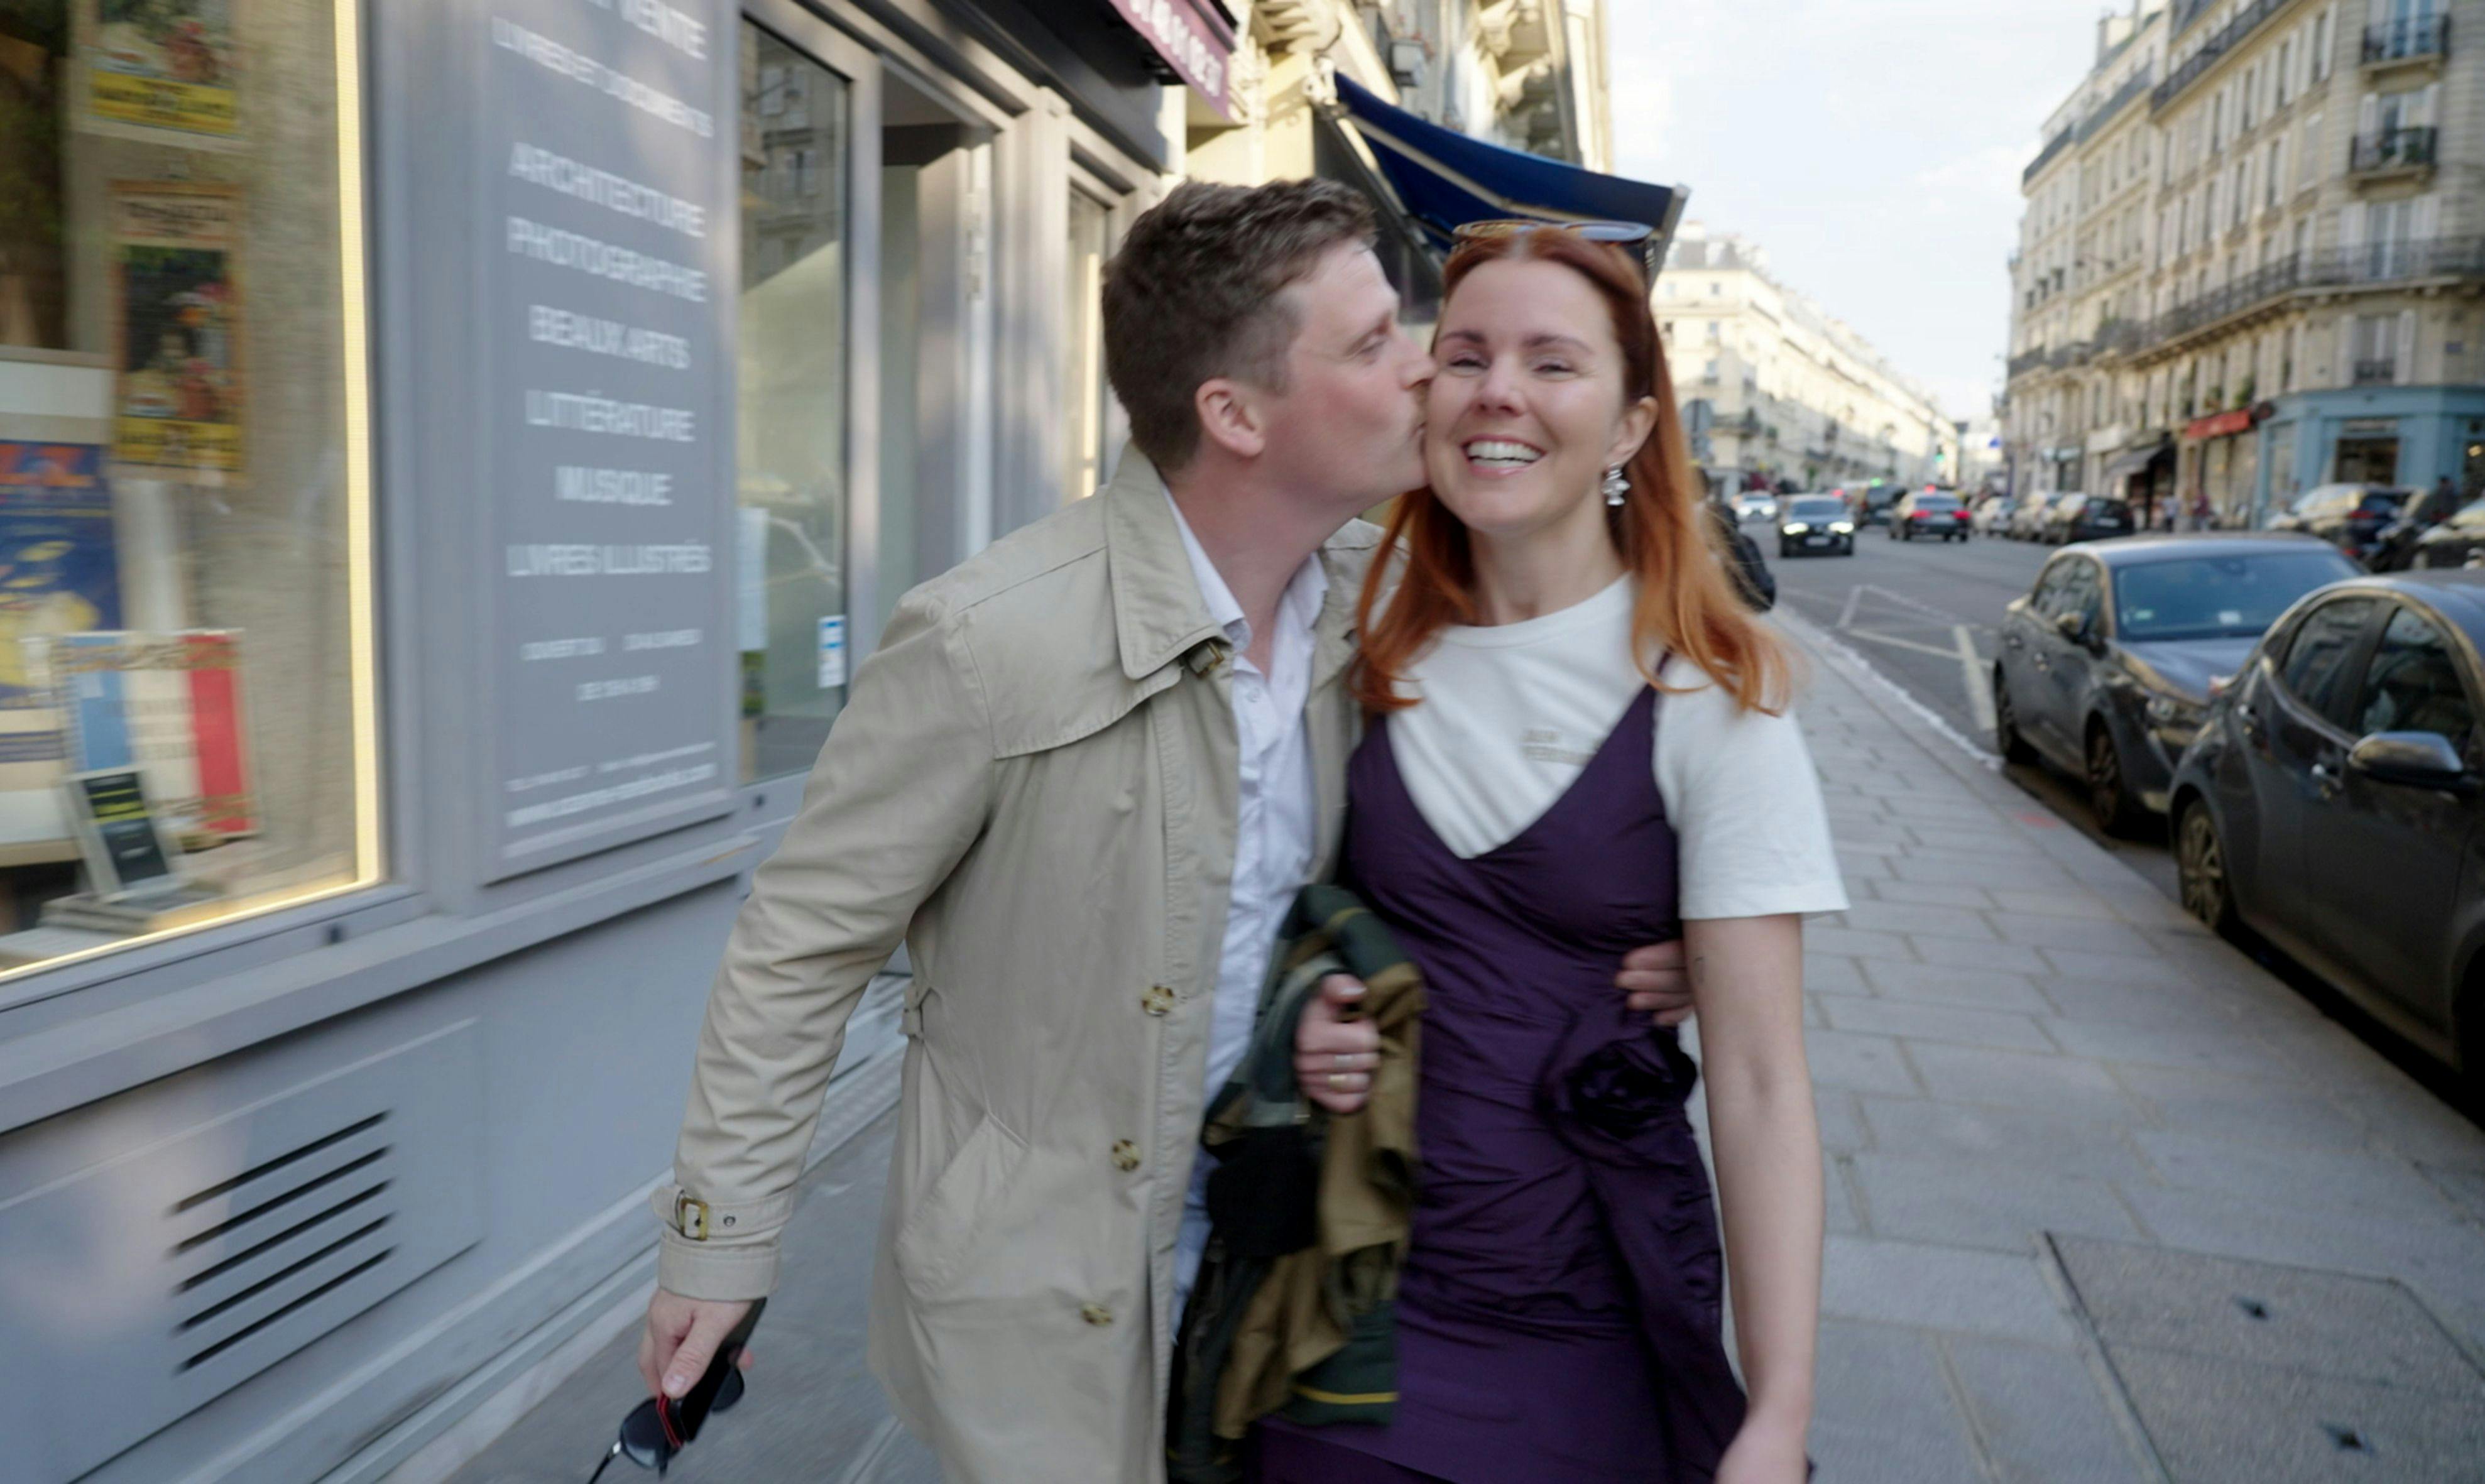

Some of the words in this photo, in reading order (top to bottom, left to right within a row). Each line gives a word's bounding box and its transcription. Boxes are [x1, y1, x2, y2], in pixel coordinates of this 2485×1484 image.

[508, 141, 706, 238] ARCHITECTURE
[506, 215, 707, 302] PHOTOGRAPHIE
[528, 304, 626, 359] BEAUX
[626, 326, 691, 369] ARTS
[555, 465, 674, 506] MUSIQUE
